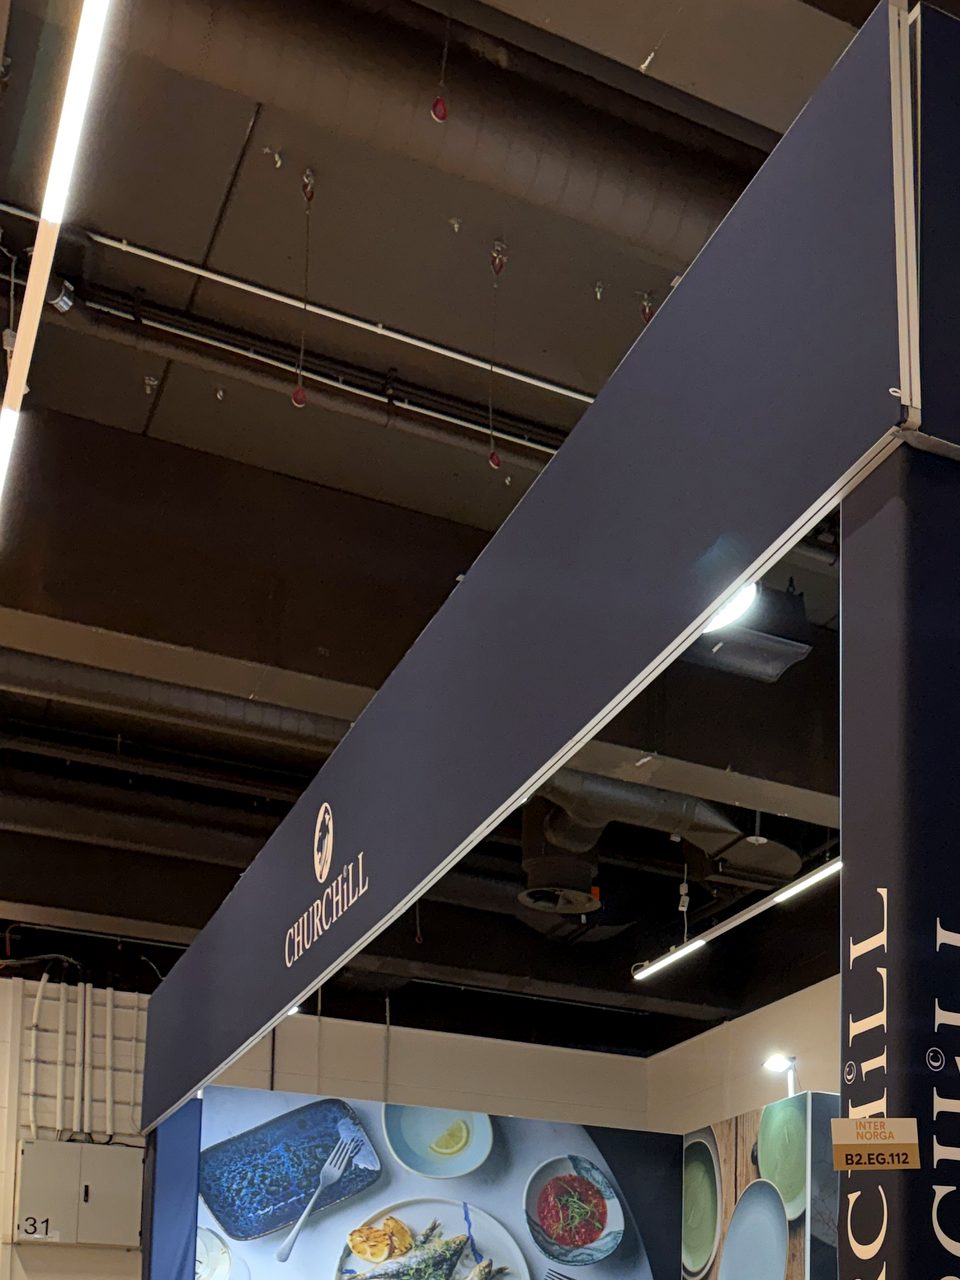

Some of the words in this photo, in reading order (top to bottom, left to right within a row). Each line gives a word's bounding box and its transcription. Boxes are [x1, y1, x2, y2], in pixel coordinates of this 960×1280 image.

[855, 1121, 886, 1131] INTER
[856, 1131, 895, 1141] NORGA
[845, 1152, 910, 1166] B2.EG.112
[23, 1216, 50, 1236] 31
